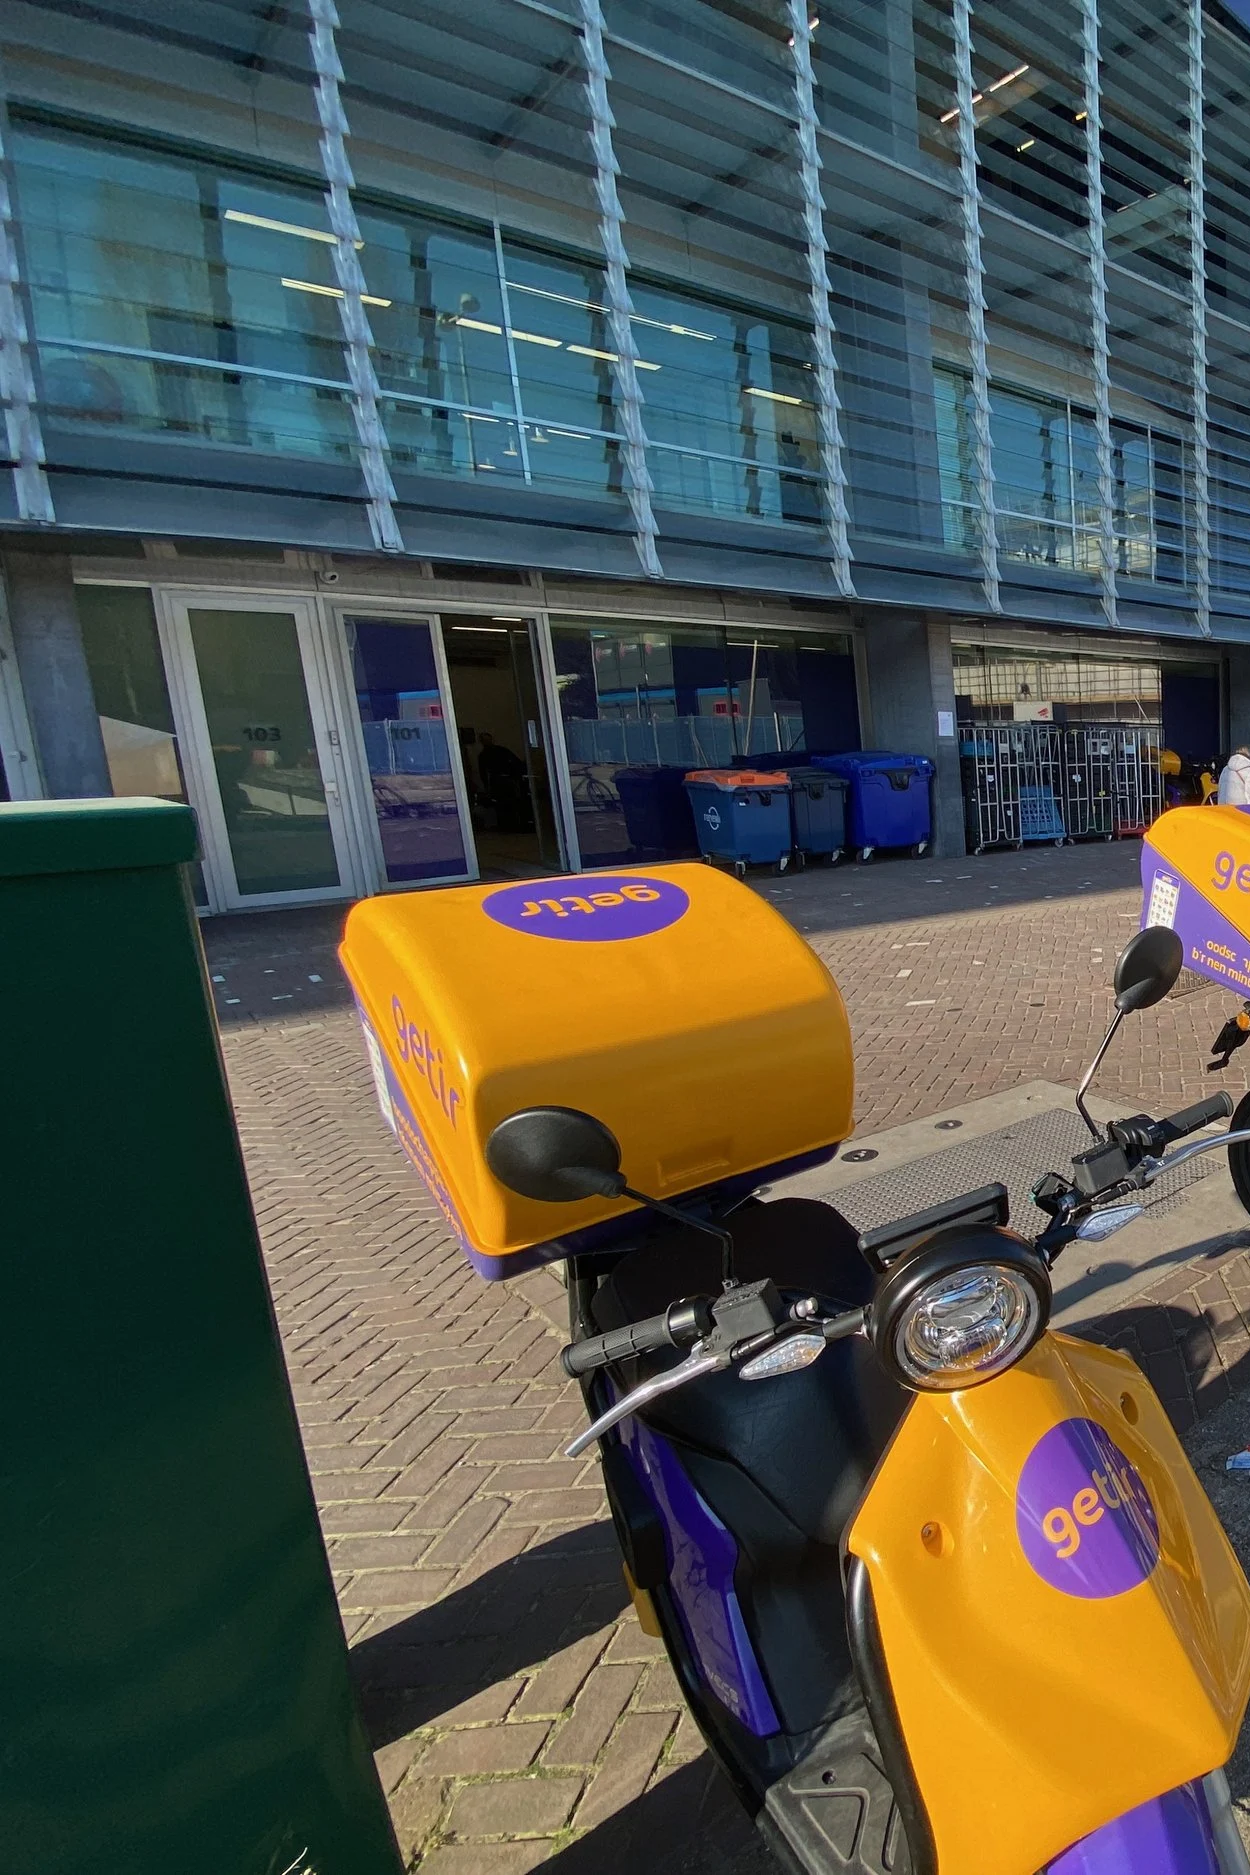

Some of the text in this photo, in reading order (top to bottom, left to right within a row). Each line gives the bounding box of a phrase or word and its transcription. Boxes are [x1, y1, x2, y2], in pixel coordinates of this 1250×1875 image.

[243, 727, 282, 742] 103
[390, 727, 421, 741] 101
[520, 884, 661, 917] getir
[391, 993, 460, 1132] getir
[1042, 1463, 1135, 1559] getir
